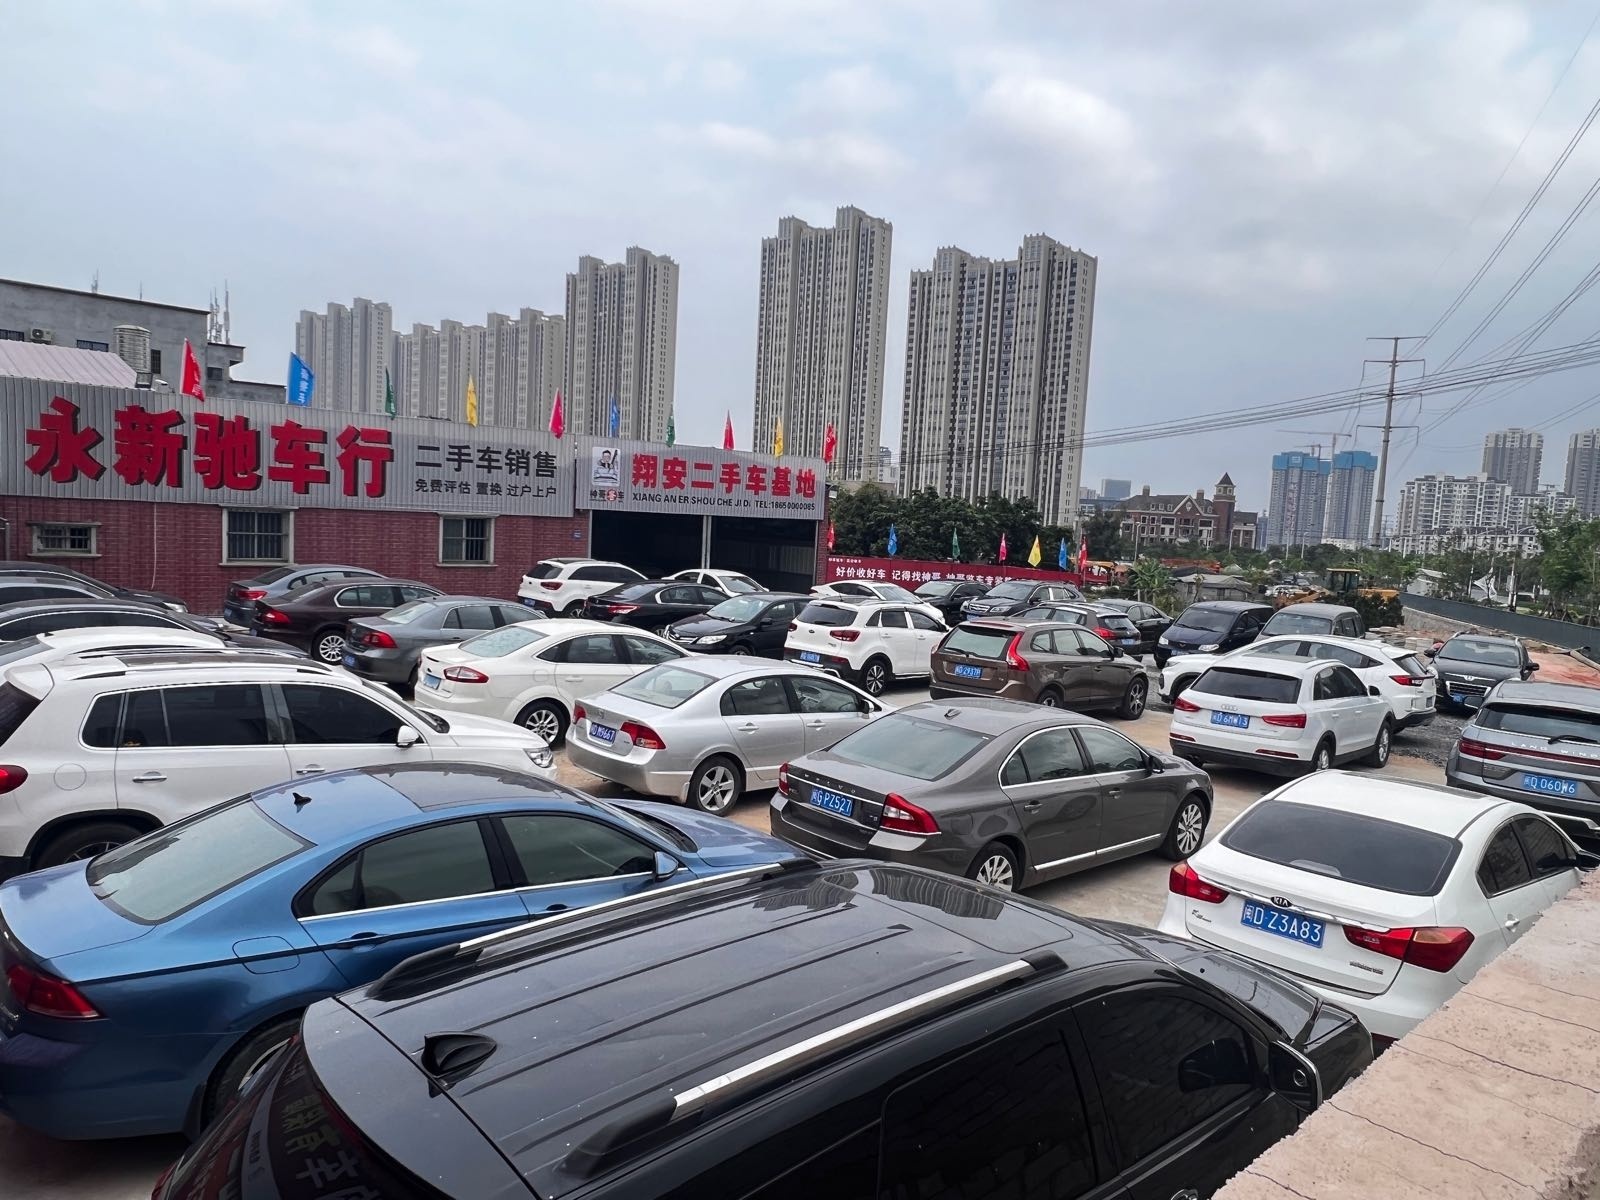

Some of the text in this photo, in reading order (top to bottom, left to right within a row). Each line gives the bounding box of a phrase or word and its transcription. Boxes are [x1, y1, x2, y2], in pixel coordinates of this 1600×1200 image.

[25, 396, 395, 498] 永新驰车行
[415, 445, 557, 478] 二手车销售
[632, 453, 816, 499] 翔安二手车基地
[415, 478, 557, 498] 免费评估 置换 过户上户
[632, 493, 661, 503] XIANG
[663, 494, 677, 503] AN
[678, 495, 690, 504] ER
[691, 496, 716, 506] SHOU
[717, 498, 732, 507] CHE
[835, 566, 886, 580] 好价收好车
[1273, 896, 1289, 907] KIA
